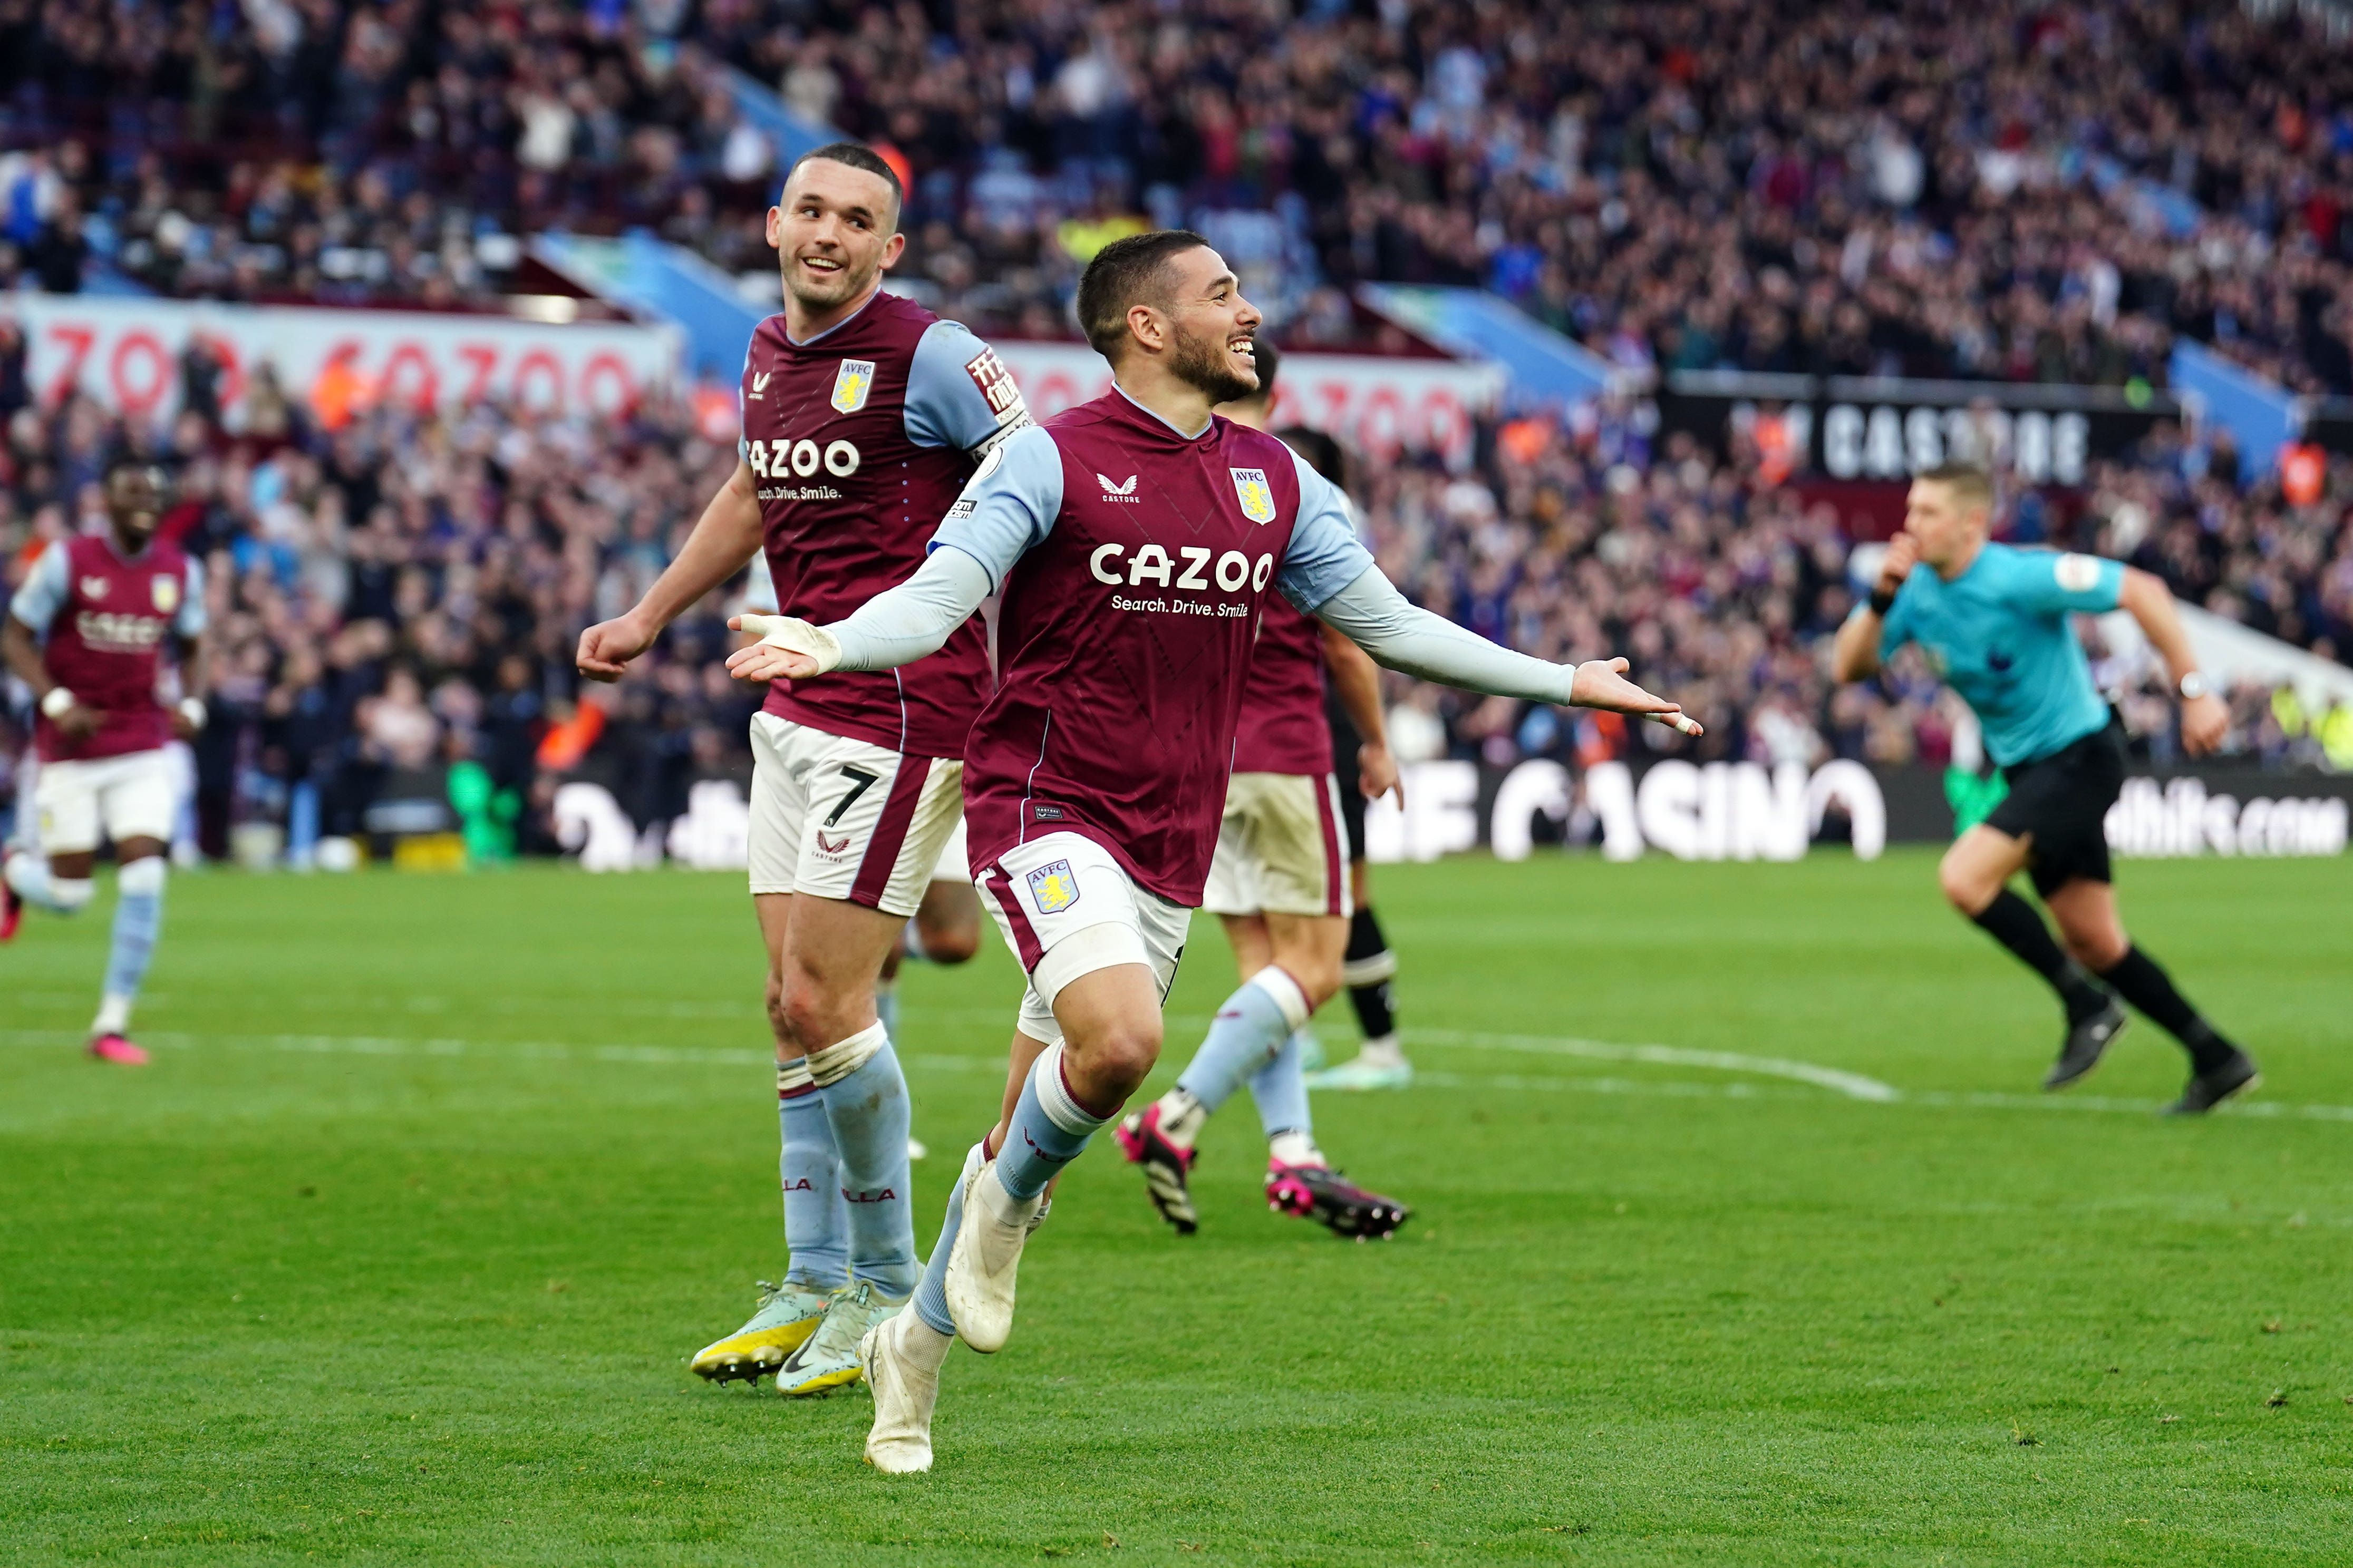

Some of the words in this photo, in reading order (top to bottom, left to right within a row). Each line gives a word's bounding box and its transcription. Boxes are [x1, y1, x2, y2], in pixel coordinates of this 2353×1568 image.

[844, 363, 872, 375] AVFC
[1236, 472, 1263, 482] AVFC
[775, 486, 800, 499] Drive.
[800, 486, 842, 499] Smile.
[1102, 494, 1140, 503] CASTORE
[1090, 543, 1273, 593] CAZOO
[1111, 595, 1168, 612] Search.
[1172, 599, 1214, 616] Drive.
[823, 765, 879, 827] 7
[811, 851, 843, 864] CASTORE
[1032, 861, 1066, 883] AVFC
